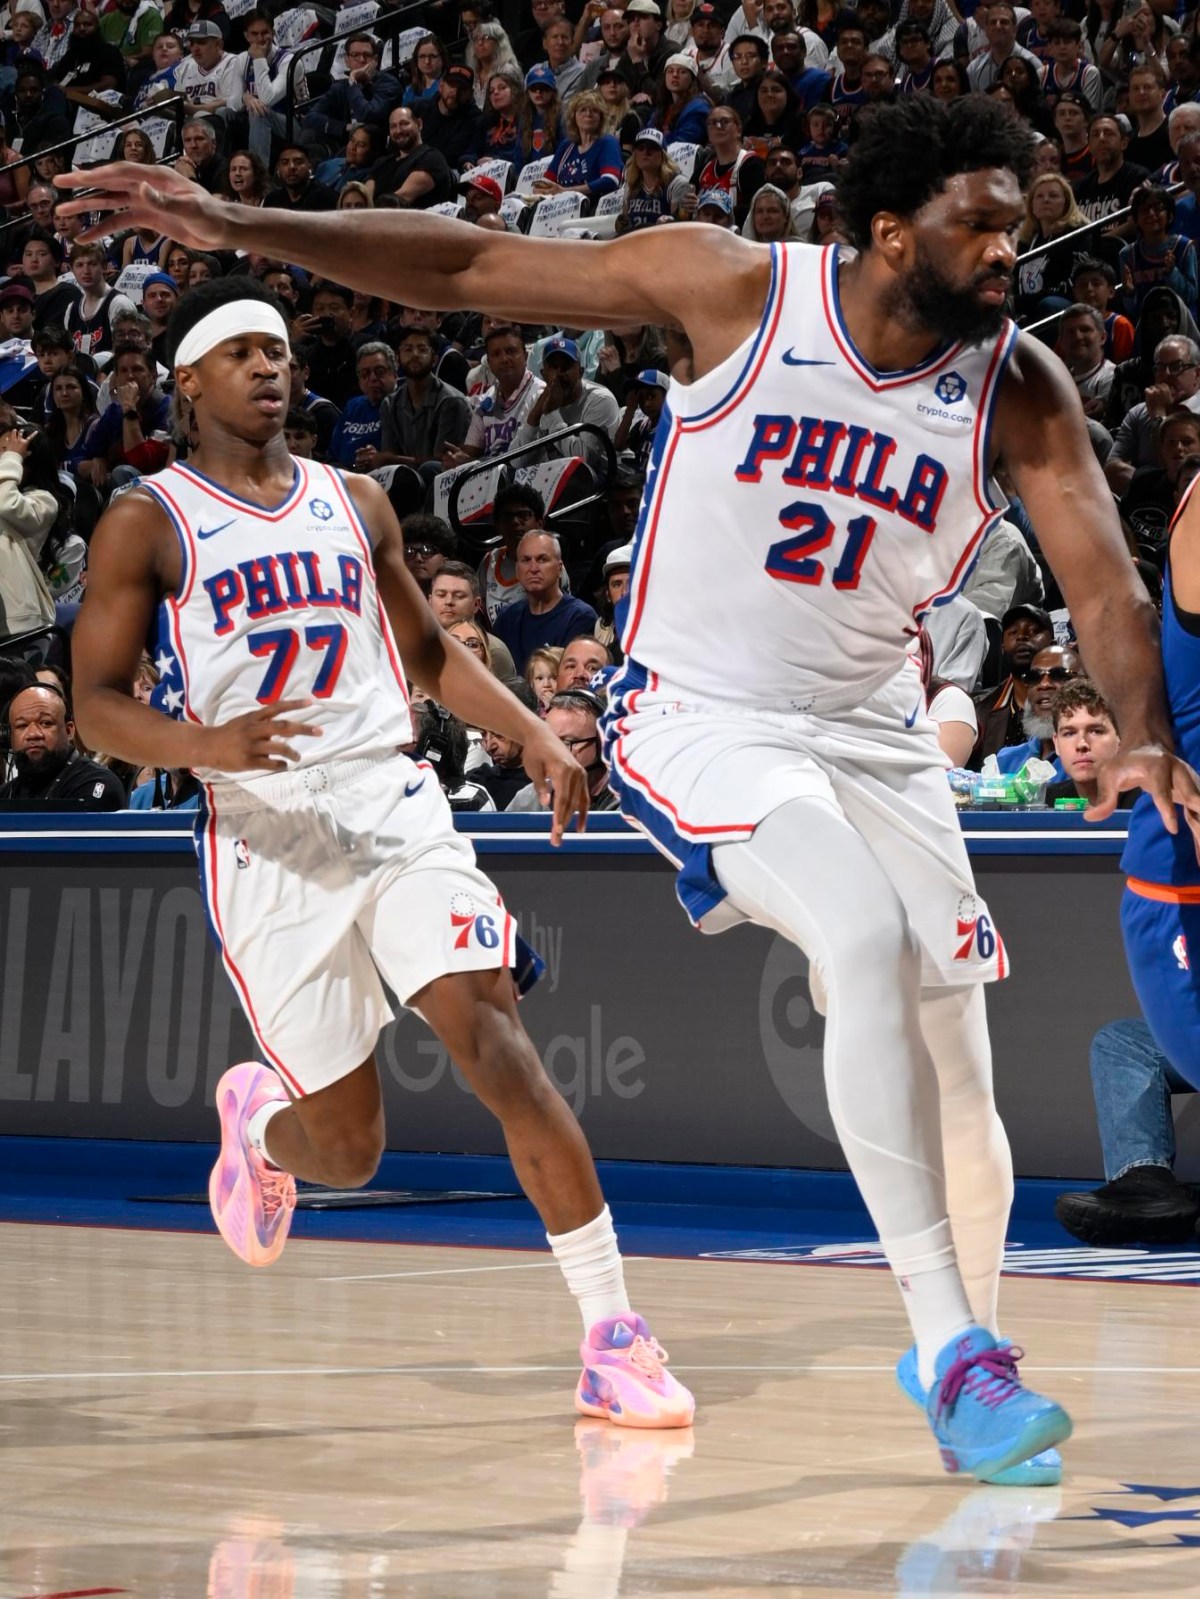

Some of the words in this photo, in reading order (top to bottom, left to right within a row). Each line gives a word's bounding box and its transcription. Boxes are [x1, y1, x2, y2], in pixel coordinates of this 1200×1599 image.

[342, 420, 382, 434] 76ERS
[916, 402, 973, 426] crypto.com
[734, 413, 950, 535] PHILA
[765, 500, 878, 590] 21
[203, 551, 363, 637] PHILA
[247, 623, 349, 706] 77
[450, 912, 500, 950] 76
[953, 914, 996, 960] 76
[384, 1003, 647, 1119] Ggle
